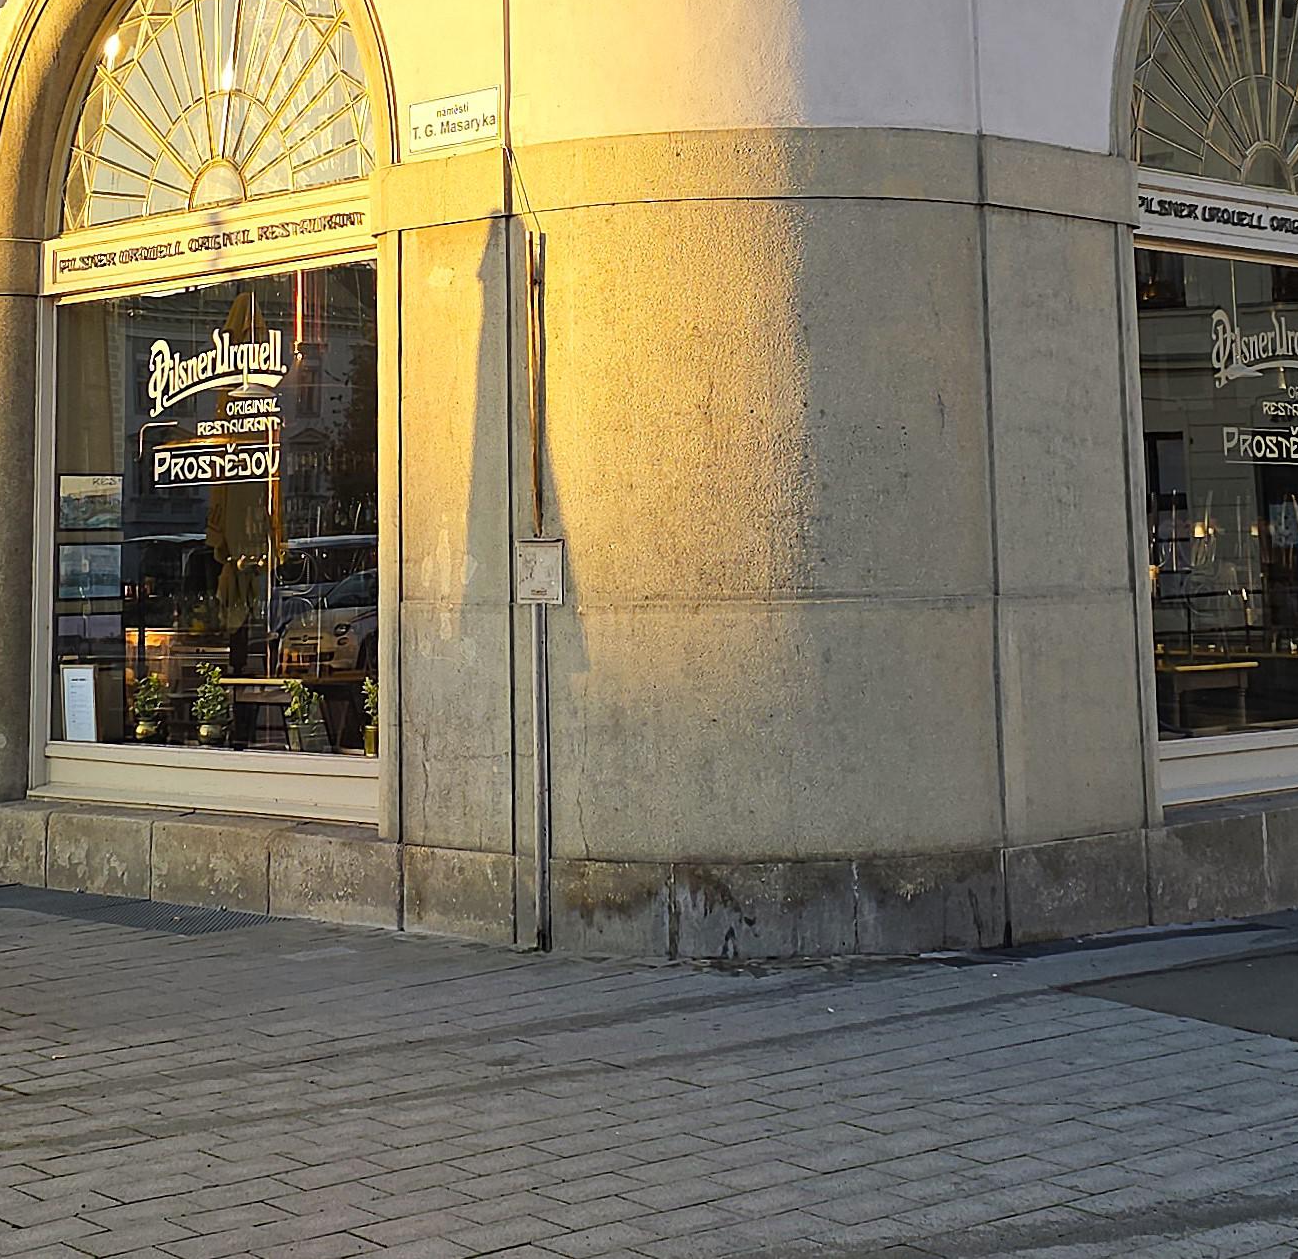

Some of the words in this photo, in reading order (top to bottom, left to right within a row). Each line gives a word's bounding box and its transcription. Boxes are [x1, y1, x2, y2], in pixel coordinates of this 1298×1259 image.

[412, 126, 422, 141] T.
[424, 122, 437, 138] G.
[439, 113, 497, 136] Masaryka
[1201, 204, 1268, 231] URQUELL
[1211, 309, 1276, 389] Pilsner
[148, 339, 218, 418] Pilsner
[226, 397, 281, 416] ORIGINAL
[197, 416, 281, 436] RESTAURANT
[154, 443, 280, 482] PROSTĚJOV
